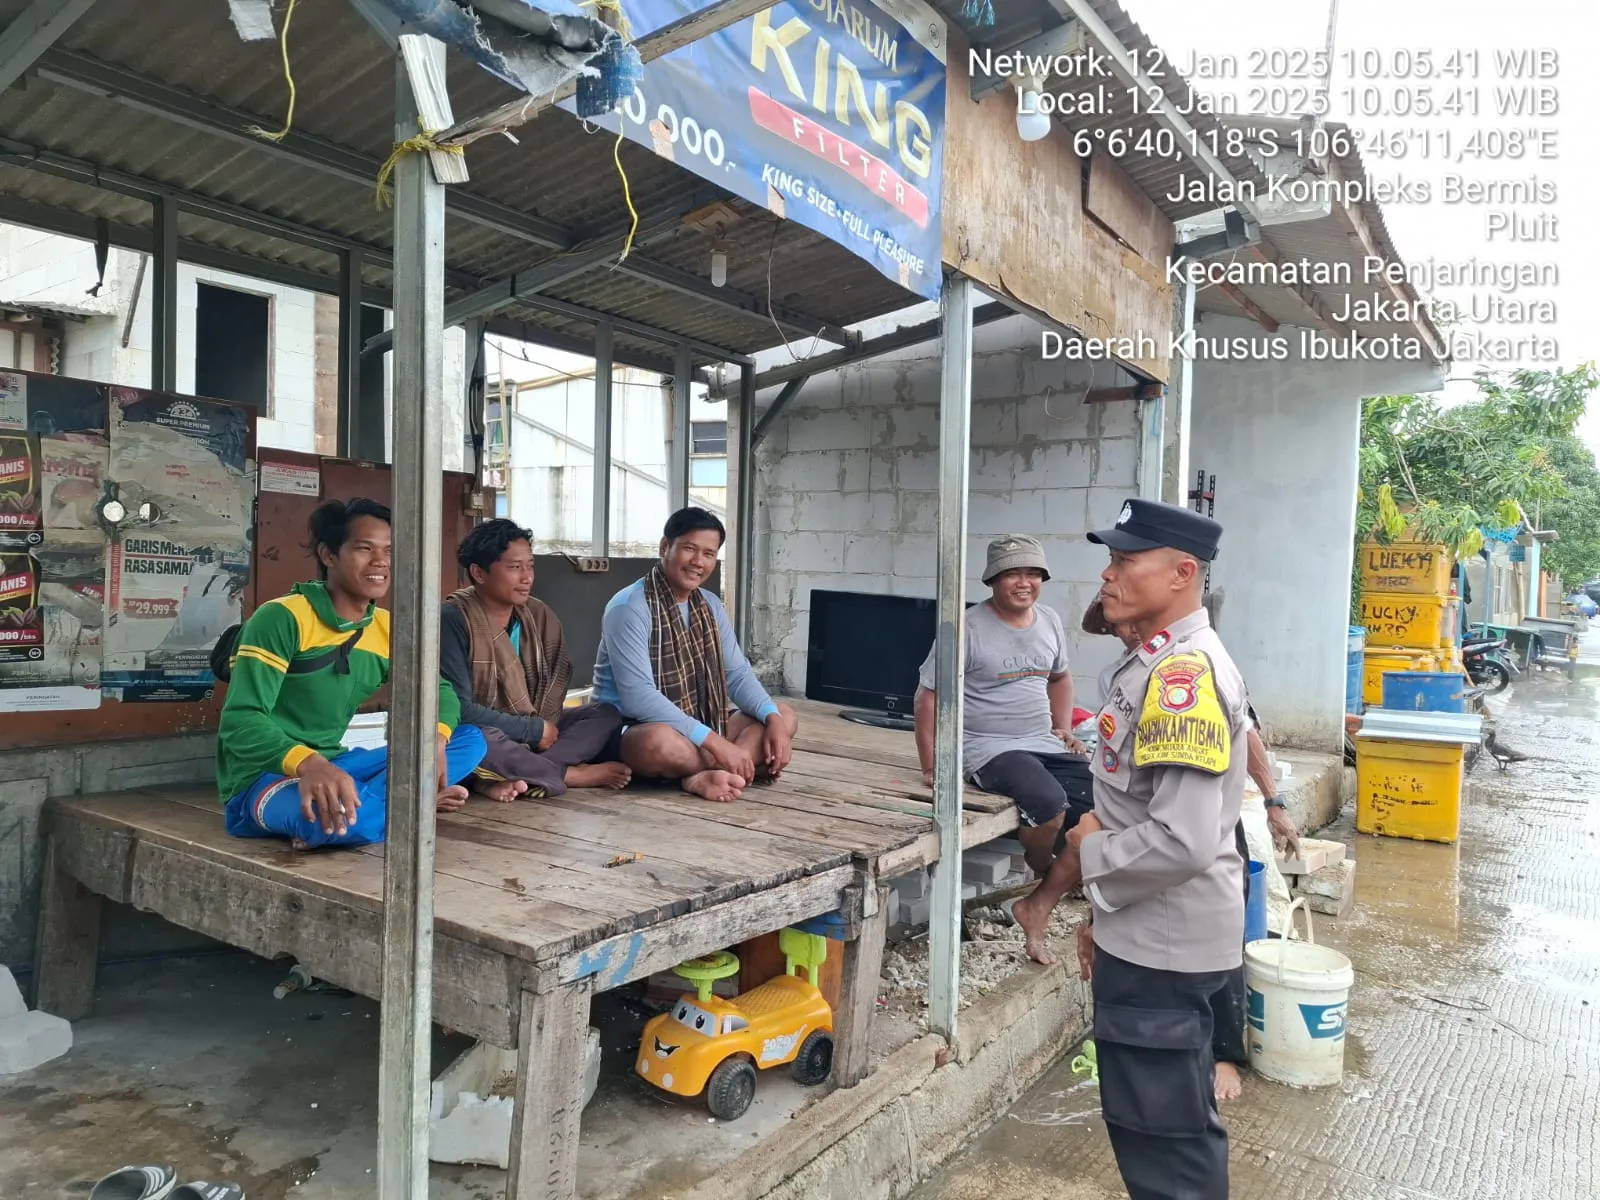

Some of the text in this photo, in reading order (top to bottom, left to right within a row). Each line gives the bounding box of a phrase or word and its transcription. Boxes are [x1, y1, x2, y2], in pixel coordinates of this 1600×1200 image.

[750, 6, 932, 178] KING
[792, 117, 906, 206] FILTER
[762, 164, 924, 275] KING SIZE FULL PLEASURE
[156, 416, 210, 430] SUPER PREMIUM
[124, 558, 155, 574] RASA
[125, 538, 159, 555] GARIS
